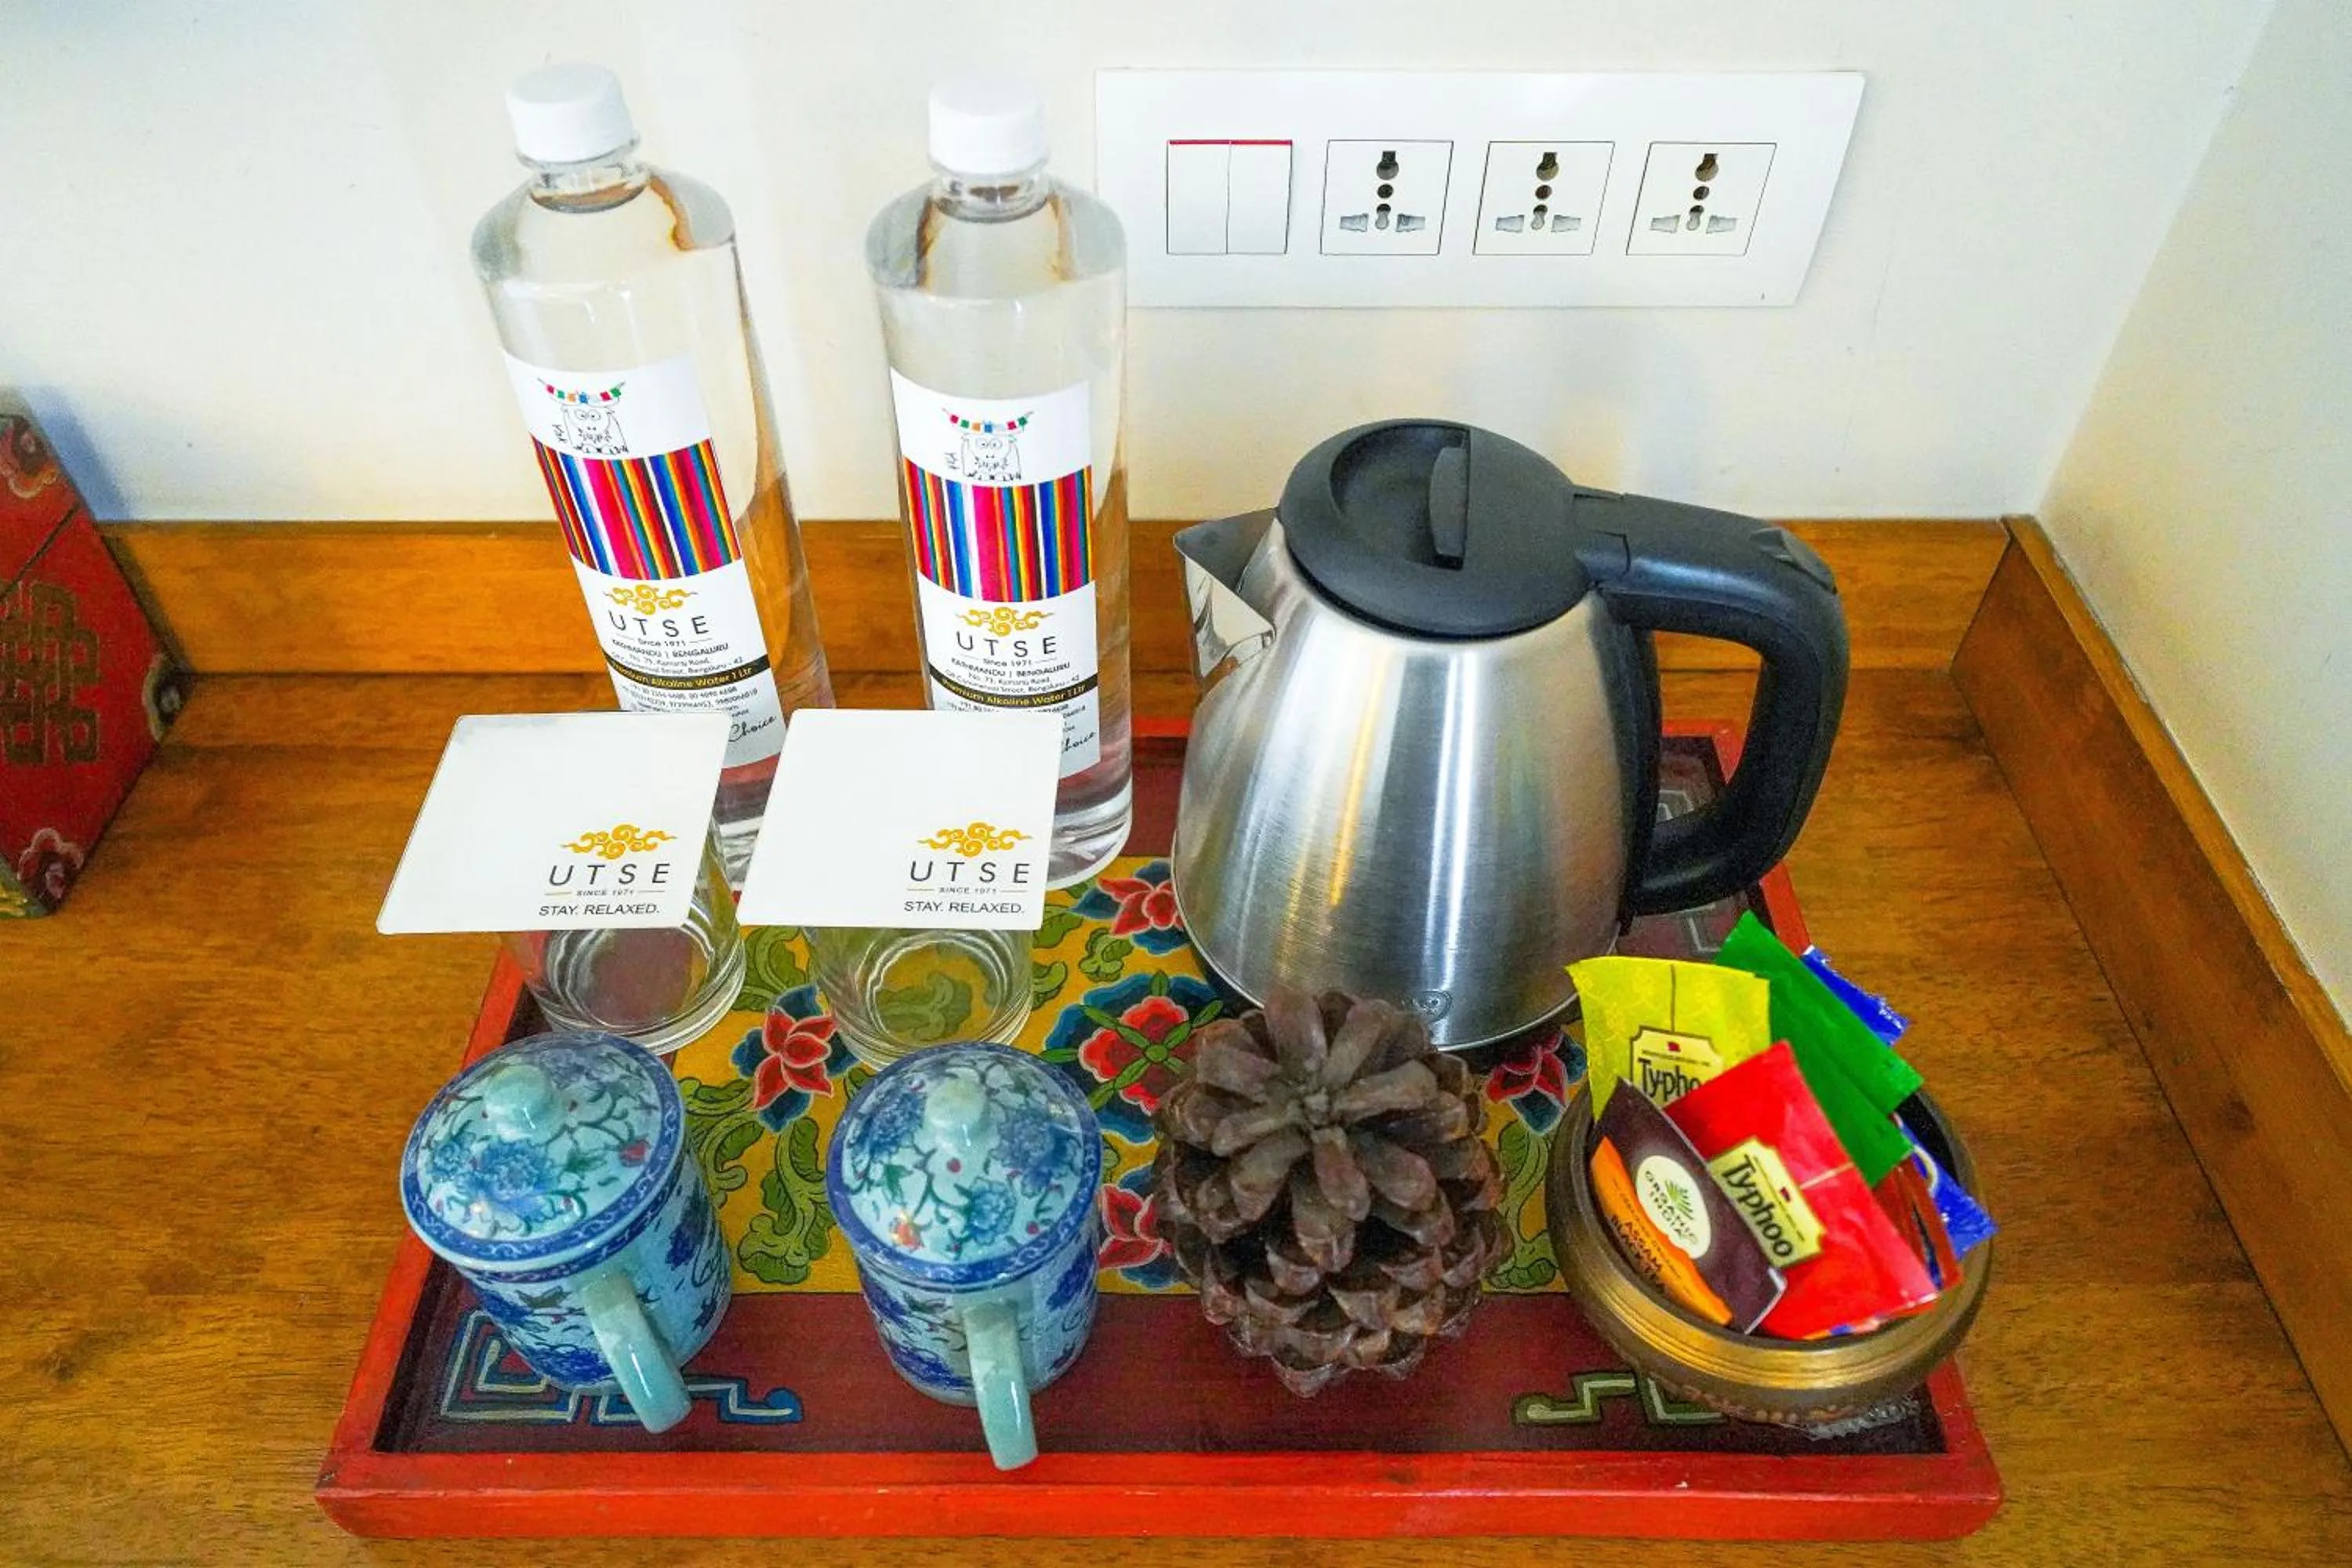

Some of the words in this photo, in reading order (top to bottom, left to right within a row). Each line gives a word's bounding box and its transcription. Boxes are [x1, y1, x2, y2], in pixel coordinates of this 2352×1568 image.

[608, 609, 710, 637] UTSE
[956, 630, 1057, 658] UTSE
[982, 657, 1008, 667] Since
[695, 675, 730, 687] Water
[1032, 692, 1066, 705] Water
[1061, 731, 1096, 754] hoice
[549, 862, 671, 887] UTSE
[910, 861, 1030, 884] UTSE
[938, 887, 971, 895] SINCE
[975, 887, 997, 895] 1971
[539, 903, 579, 916] STAY.
[583, 903, 660, 916] RELAXED.
[903, 901, 944, 913] STAY.
[948, 902, 1025, 914] RELAXED.
[1636, 1057, 1701, 1102] Typho
[1721, 1153, 1793, 1258] Typhoo
[1624, 1220, 1663, 1272] ASSAM
